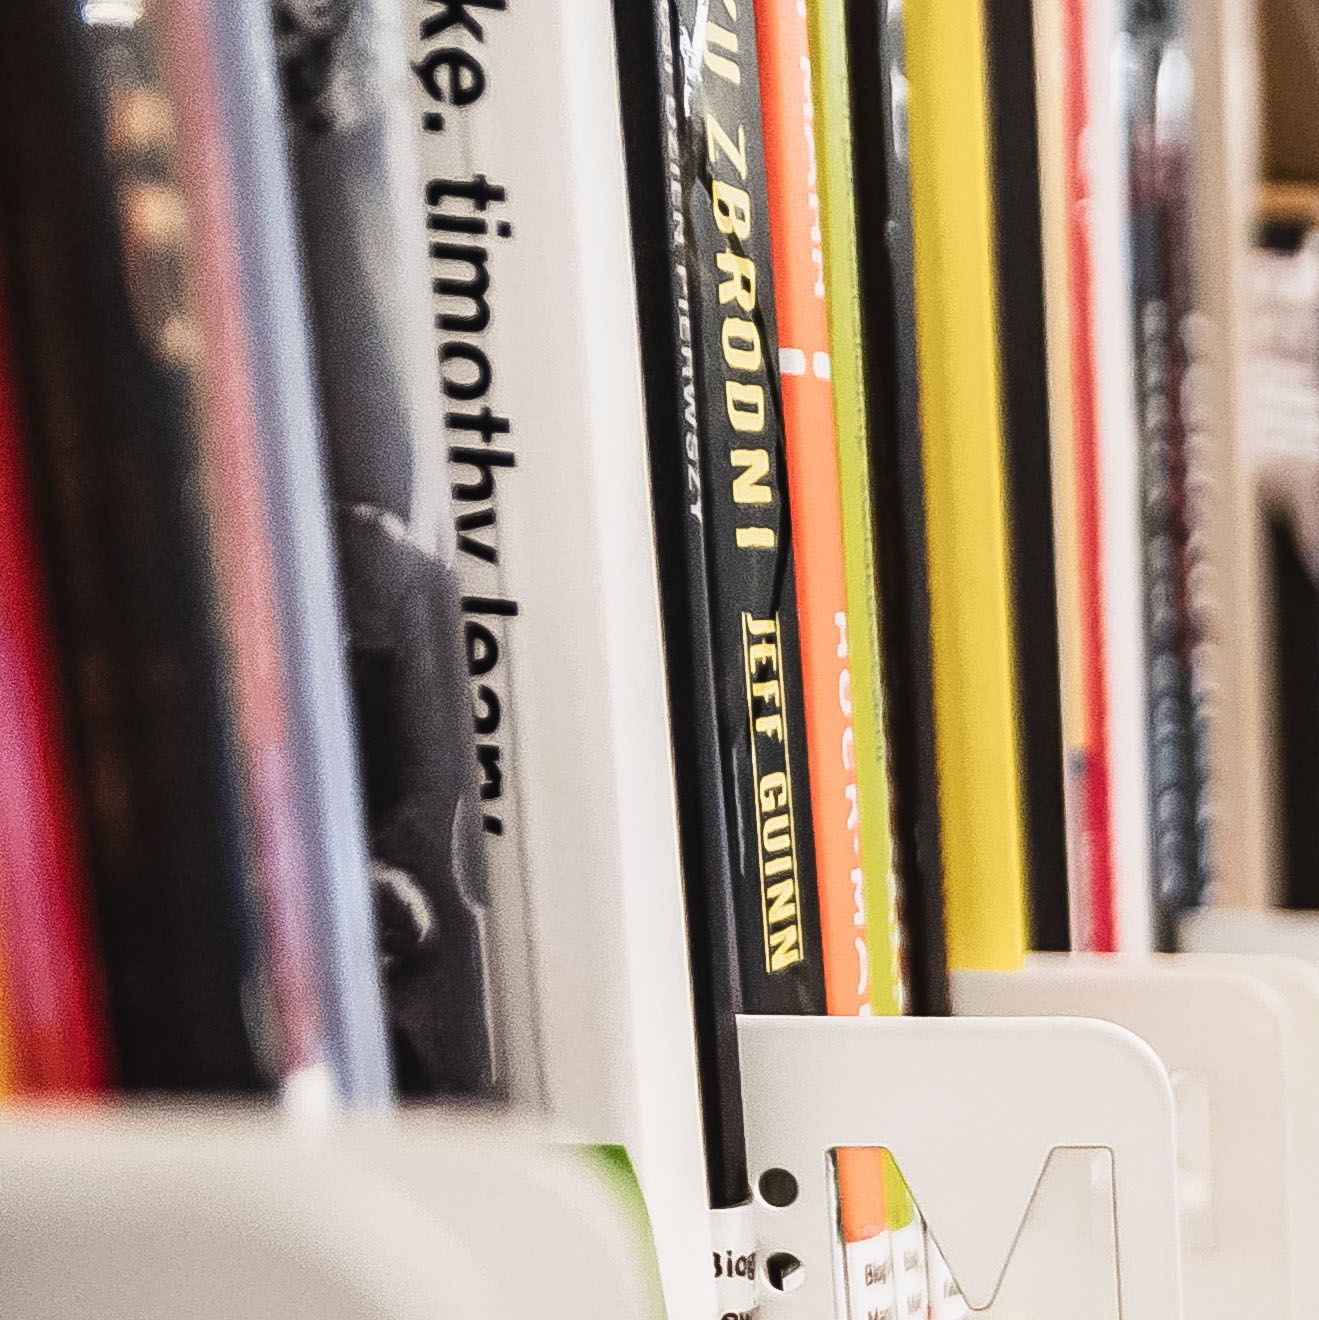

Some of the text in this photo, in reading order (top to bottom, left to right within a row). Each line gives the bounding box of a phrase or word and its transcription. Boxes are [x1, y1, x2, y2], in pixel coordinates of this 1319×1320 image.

[425, 174, 517, 563] timothy
[706, 113, 777, 550] ZBRODNI
[747, 614, 804, 972] JEFF GUINN
